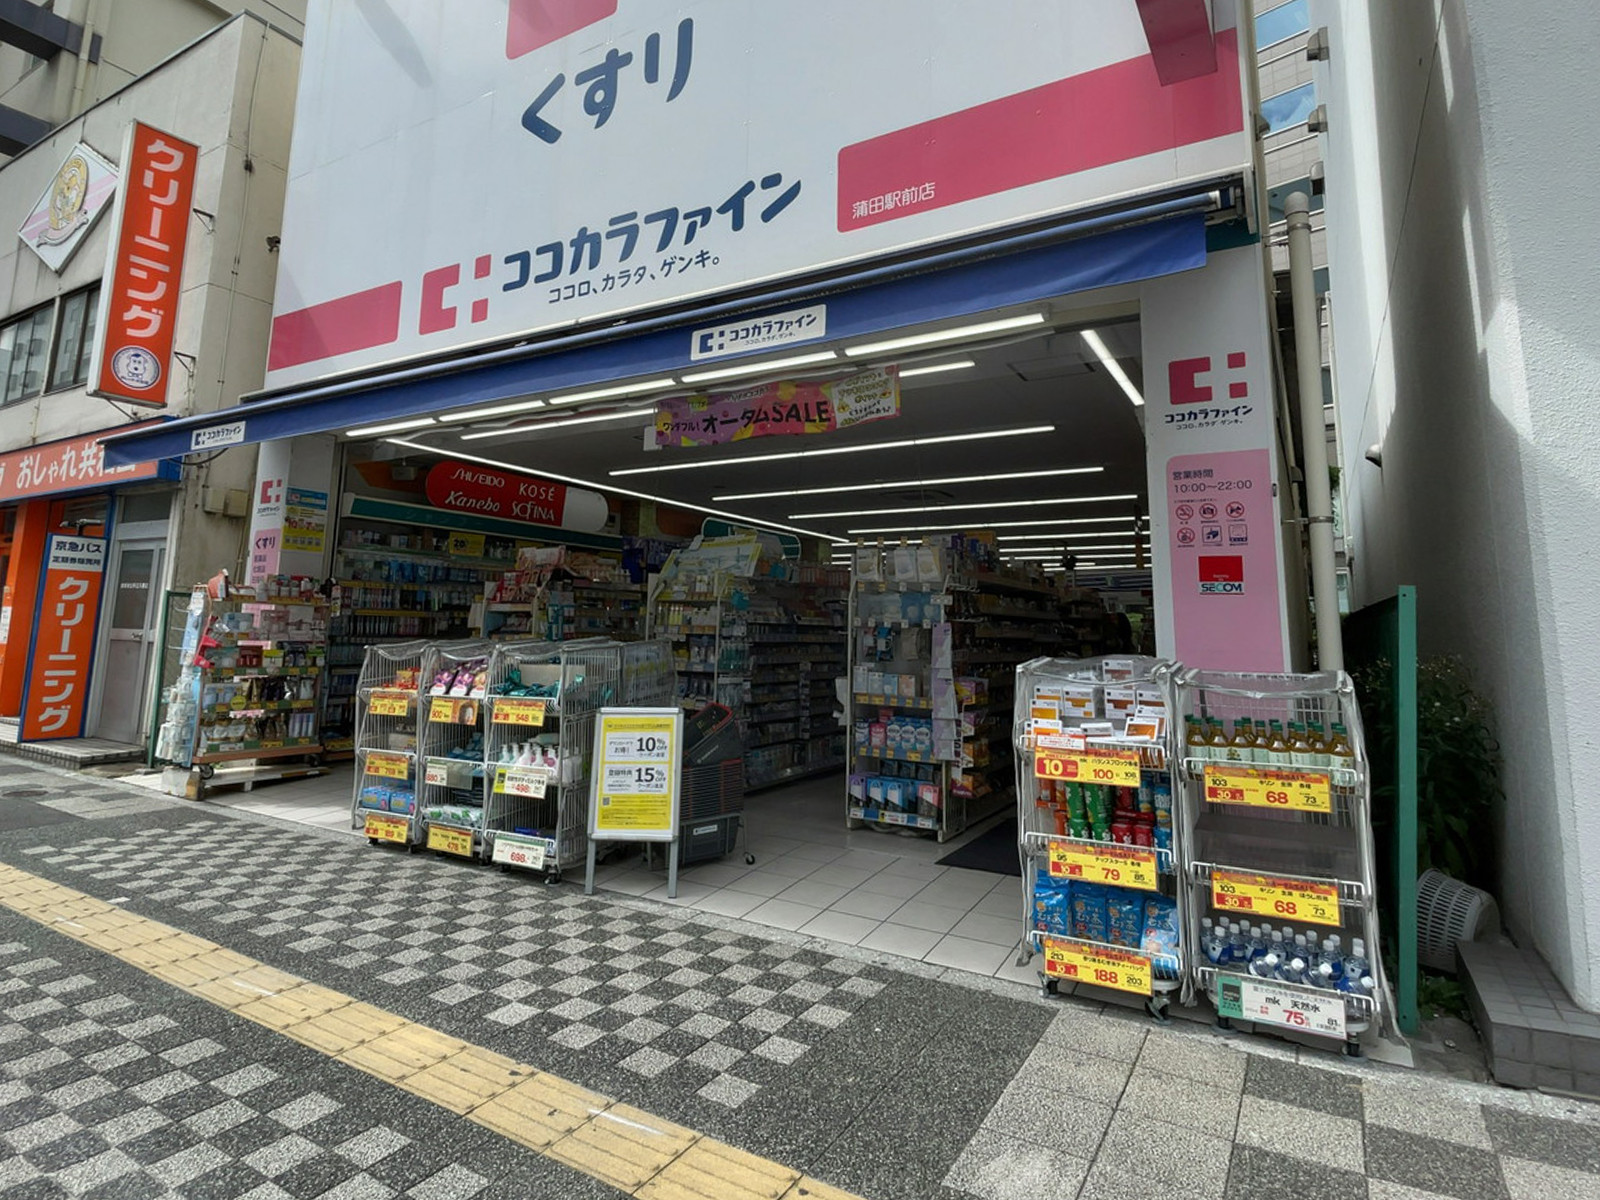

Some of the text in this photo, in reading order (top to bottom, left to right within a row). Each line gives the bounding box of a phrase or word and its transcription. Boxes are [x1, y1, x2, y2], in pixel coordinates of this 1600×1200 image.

[521, 17, 694, 144] くすり
[852, 182, 936, 219] 蒲田駅前店
[122, 138, 185, 338] クリーニング
[502, 172, 801, 292] ココカラファイン
[729, 313, 817, 342] ココカラファイン
[702, 401, 832, 434] オータムSALE
[1164, 405, 1253, 424] ココカラファイン
[16, 440, 136, 489] おしゃれ共
[451, 468, 505, 488] SHISEIDO
[1172, 469, 1213, 480] 営業時間
[445, 490, 556, 522] Kanebo SOFINA
[55, 540, 102, 554] 京急バス
[255, 536, 276, 549] くすり
[1201, 582, 1242, 593] SECOM
[38, 576, 89, 733] クリーニング
[1043, 759, 1063, 775] 10
[1092, 768, 1114, 780] 100
[1211, 778, 1227, 787] 103
[1266, 790, 1317, 804] 68 73
[1101, 867, 1120, 881] 79
[1274, 900, 1326, 916] 68 73
[1094, 968, 1143, 986] 188 203
[1290, 999, 1320, 1013] 天然水
[1283, 1009, 1305, 1026] 75
